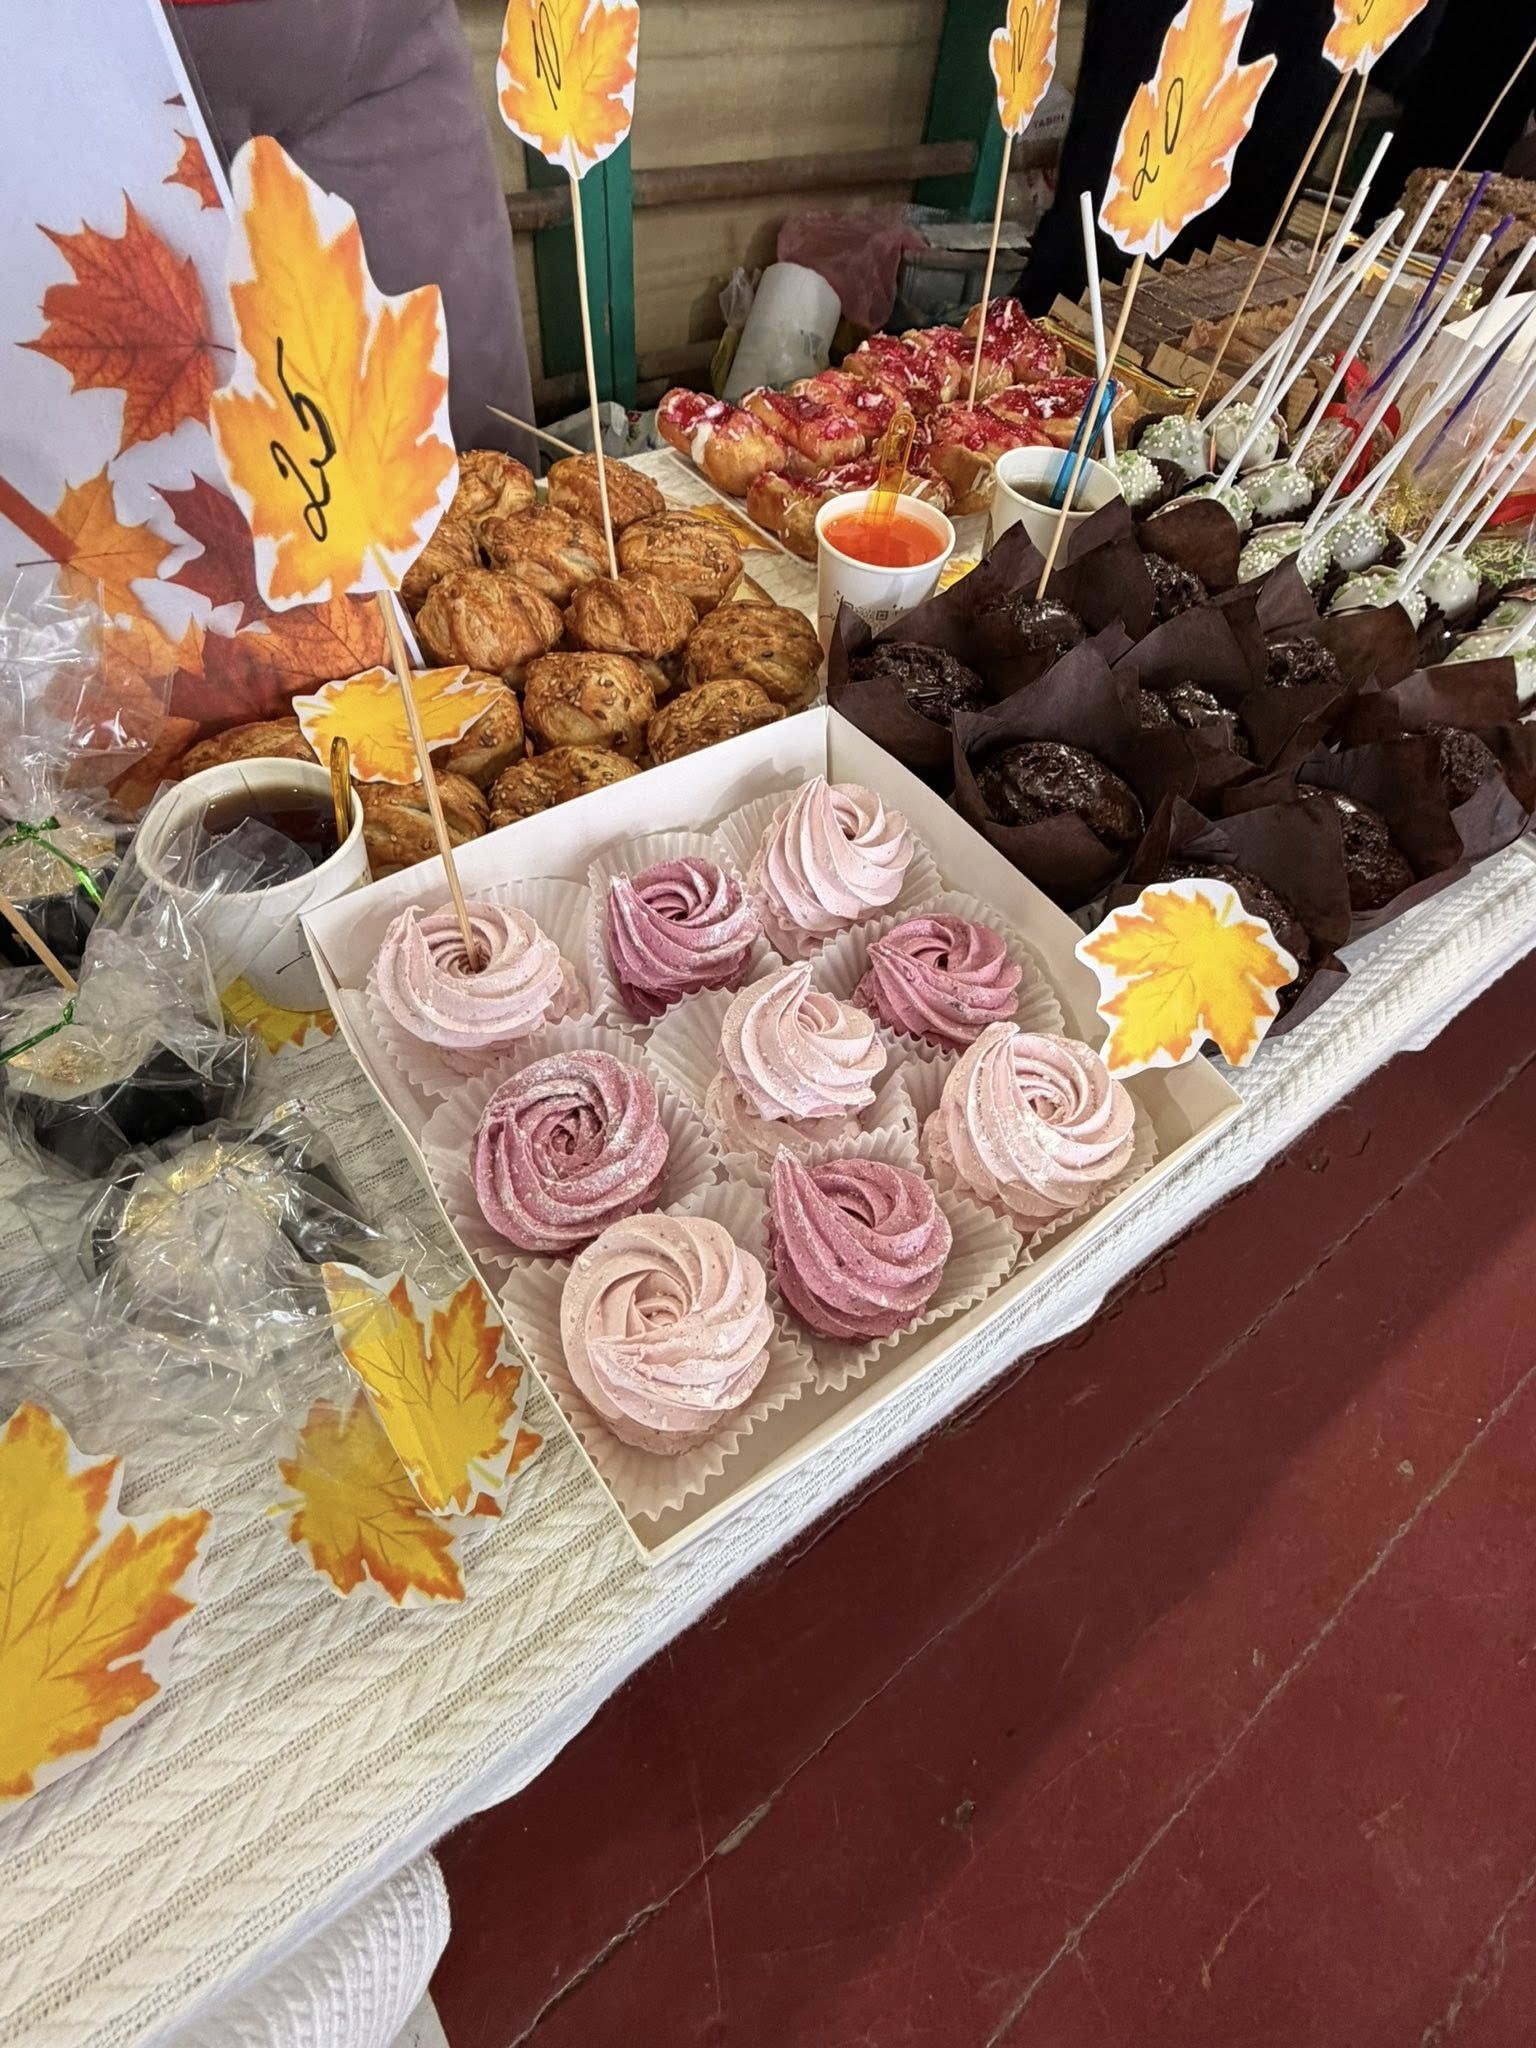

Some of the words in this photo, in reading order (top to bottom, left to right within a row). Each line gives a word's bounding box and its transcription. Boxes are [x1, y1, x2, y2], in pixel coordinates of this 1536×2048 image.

[531, 1, 561, 111] 10
[1010, 6, 1029, 93] 10
[1132, 77, 1184, 202] 20
[270, 336, 337, 543] 25
